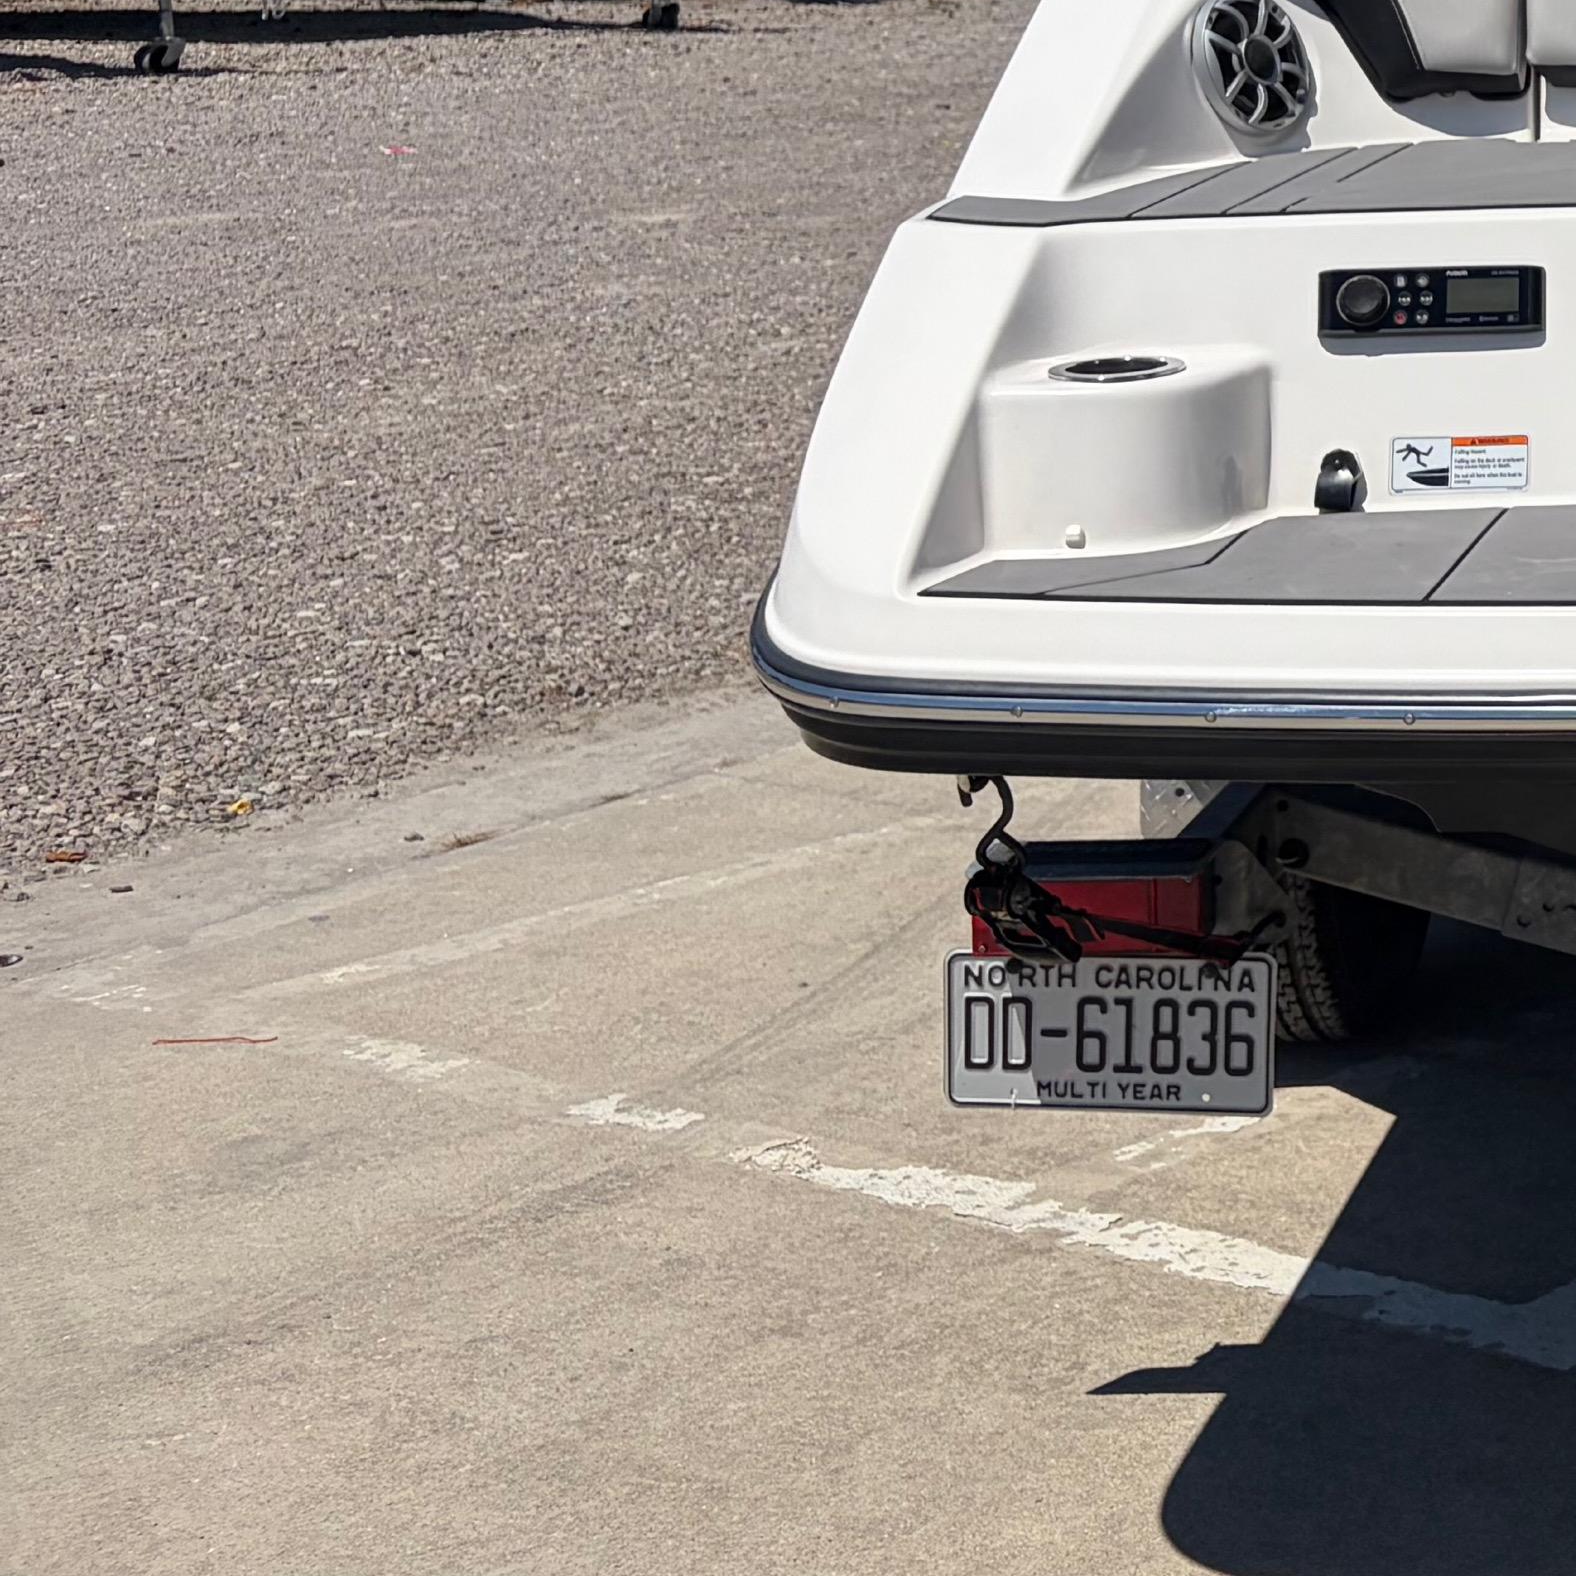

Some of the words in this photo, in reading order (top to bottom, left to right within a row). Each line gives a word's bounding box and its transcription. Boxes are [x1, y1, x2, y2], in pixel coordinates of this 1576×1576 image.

[964, 963, 1077, 988] NORTH
[1094, 964, 1256, 993] CAROLINA
[963, 995, 1257, 1078] DD-61836
[1036, 1080, 1108, 1100] MULTI
[1117, 1082, 1182, 1102] YEAR
